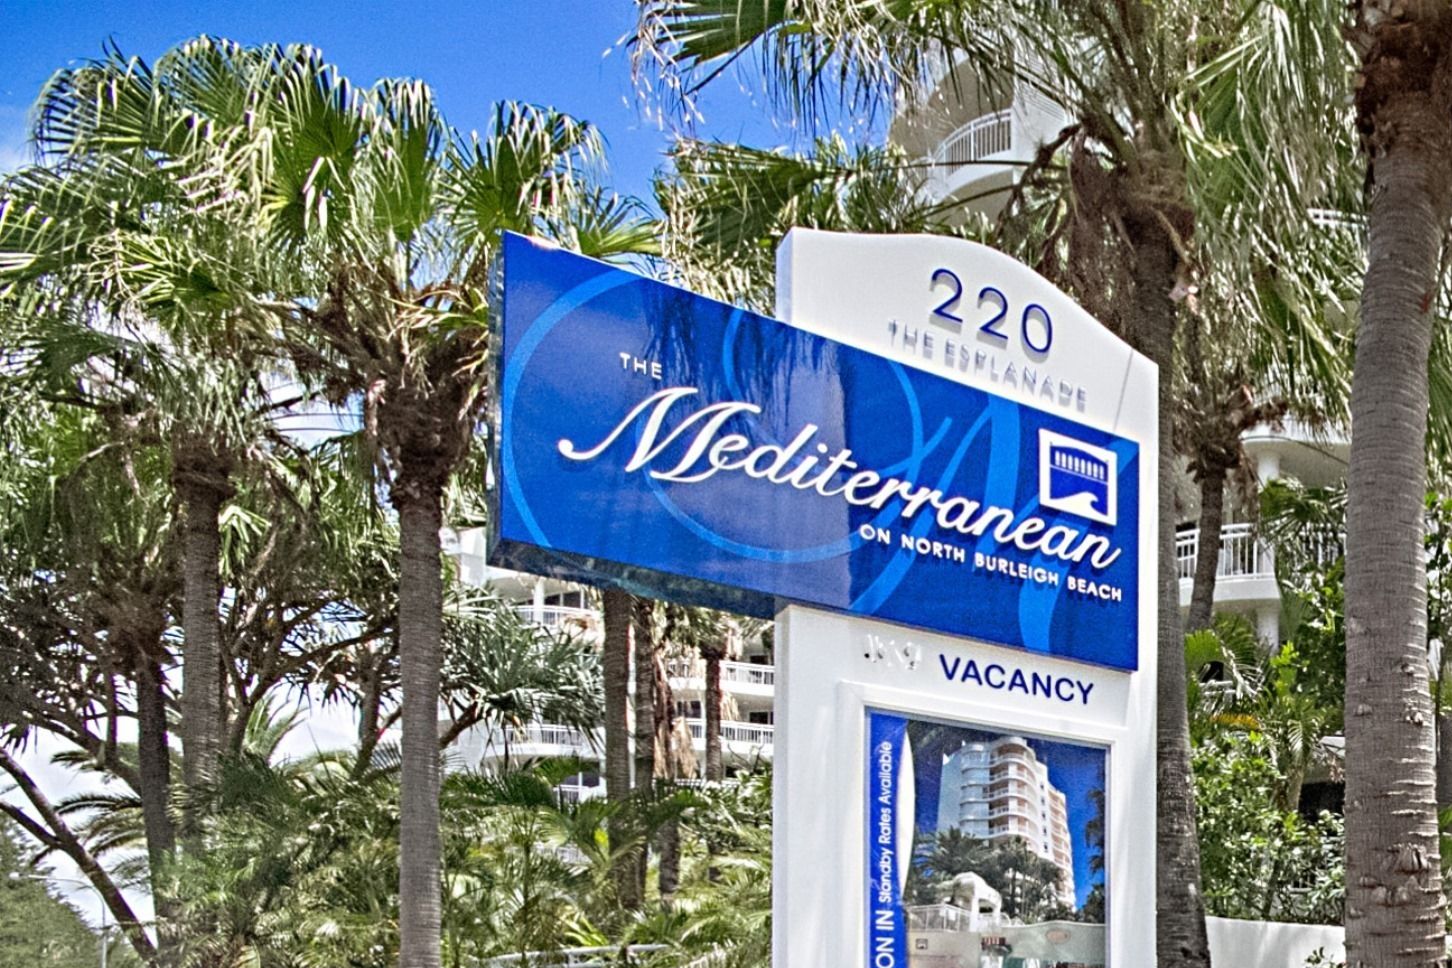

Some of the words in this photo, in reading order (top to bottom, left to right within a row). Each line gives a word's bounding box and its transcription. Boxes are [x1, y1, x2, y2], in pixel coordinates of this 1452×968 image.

[931, 267, 1053, 354] 220
[619, 352, 663, 380] THE
[888, 318, 935, 357] THE
[944, 339, 1088, 410] ESPLANADE
[557, 386, 1122, 569] Mediterranean
[859, 523, 891, 545] ON
[901, 533, 966, 563] NORTH
[974, 552, 1060, 586] BURLEIGH
[1067, 575, 1123, 602] BEACH
[939, 653, 1094, 705] VACANCY
[878, 741, 893, 806] Available
[878, 807, 892, 845] Rates
[878, 847, 894, 904] Standby
[875, 909, 895, 931] IN
